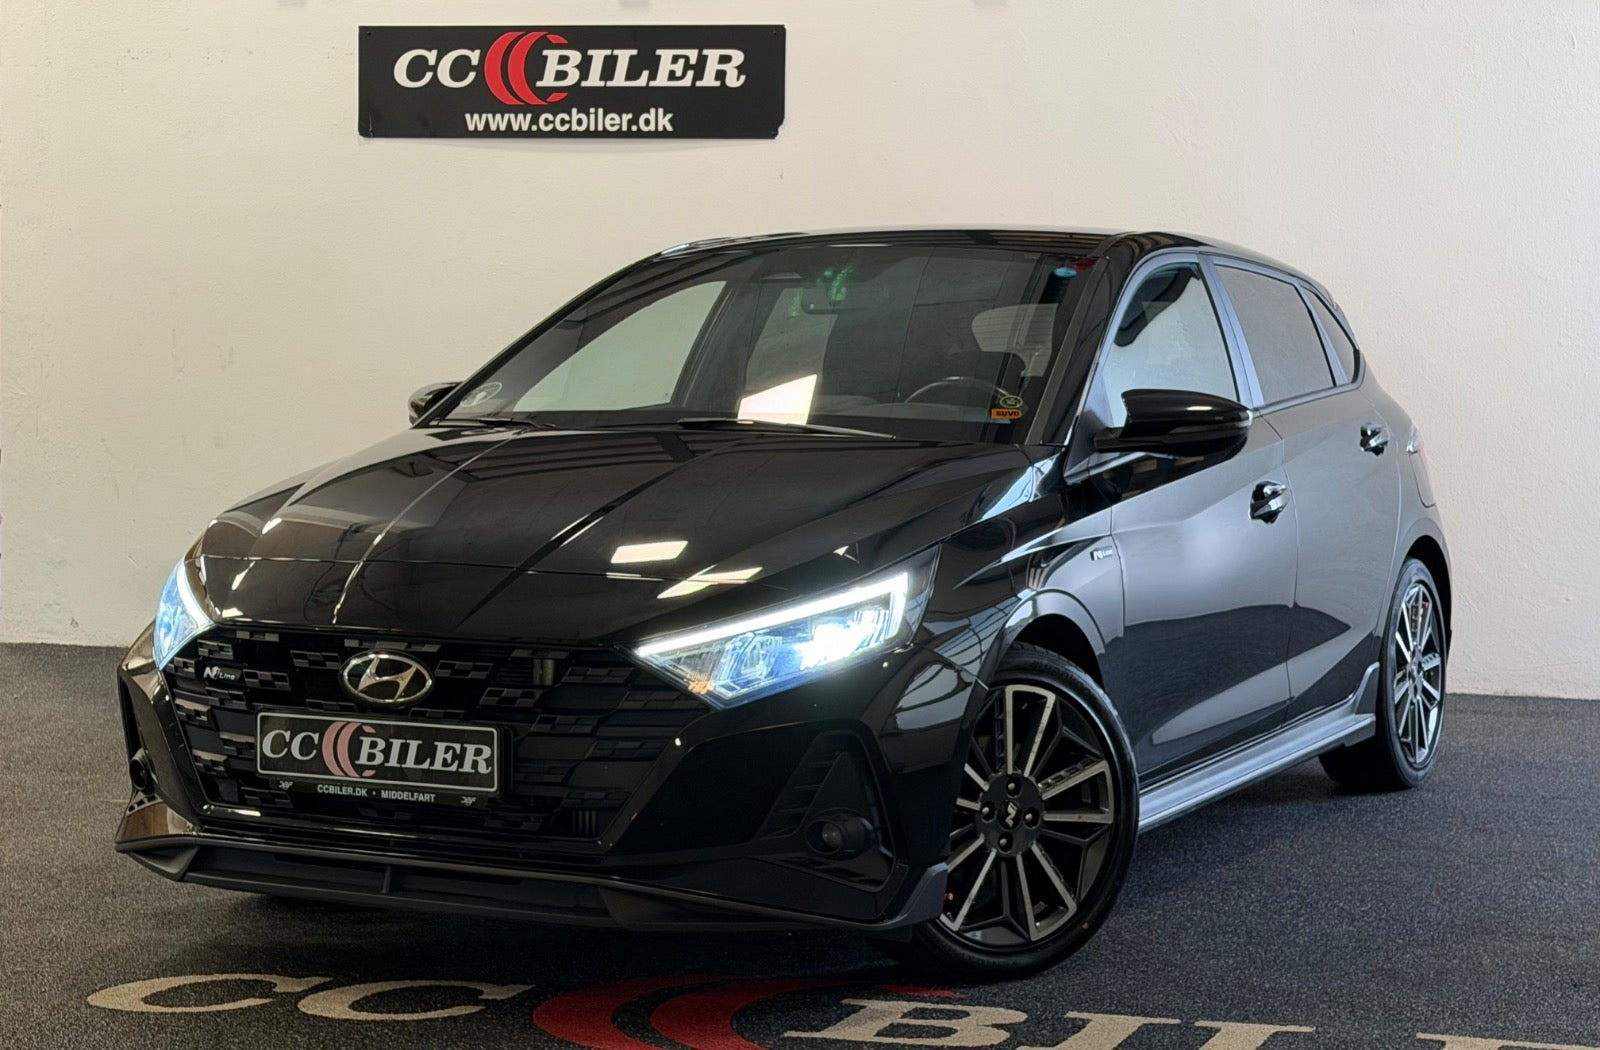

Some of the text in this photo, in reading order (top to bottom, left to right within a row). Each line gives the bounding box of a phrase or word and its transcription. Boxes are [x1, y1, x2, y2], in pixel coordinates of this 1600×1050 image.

[394, 49, 746, 89] CC BILER
[465, 108, 674, 132] www.ccbiler.dk
[262, 729, 492, 775] CC BILER
[317, 784, 436, 803] CCBILER.DK MIDDELFART
